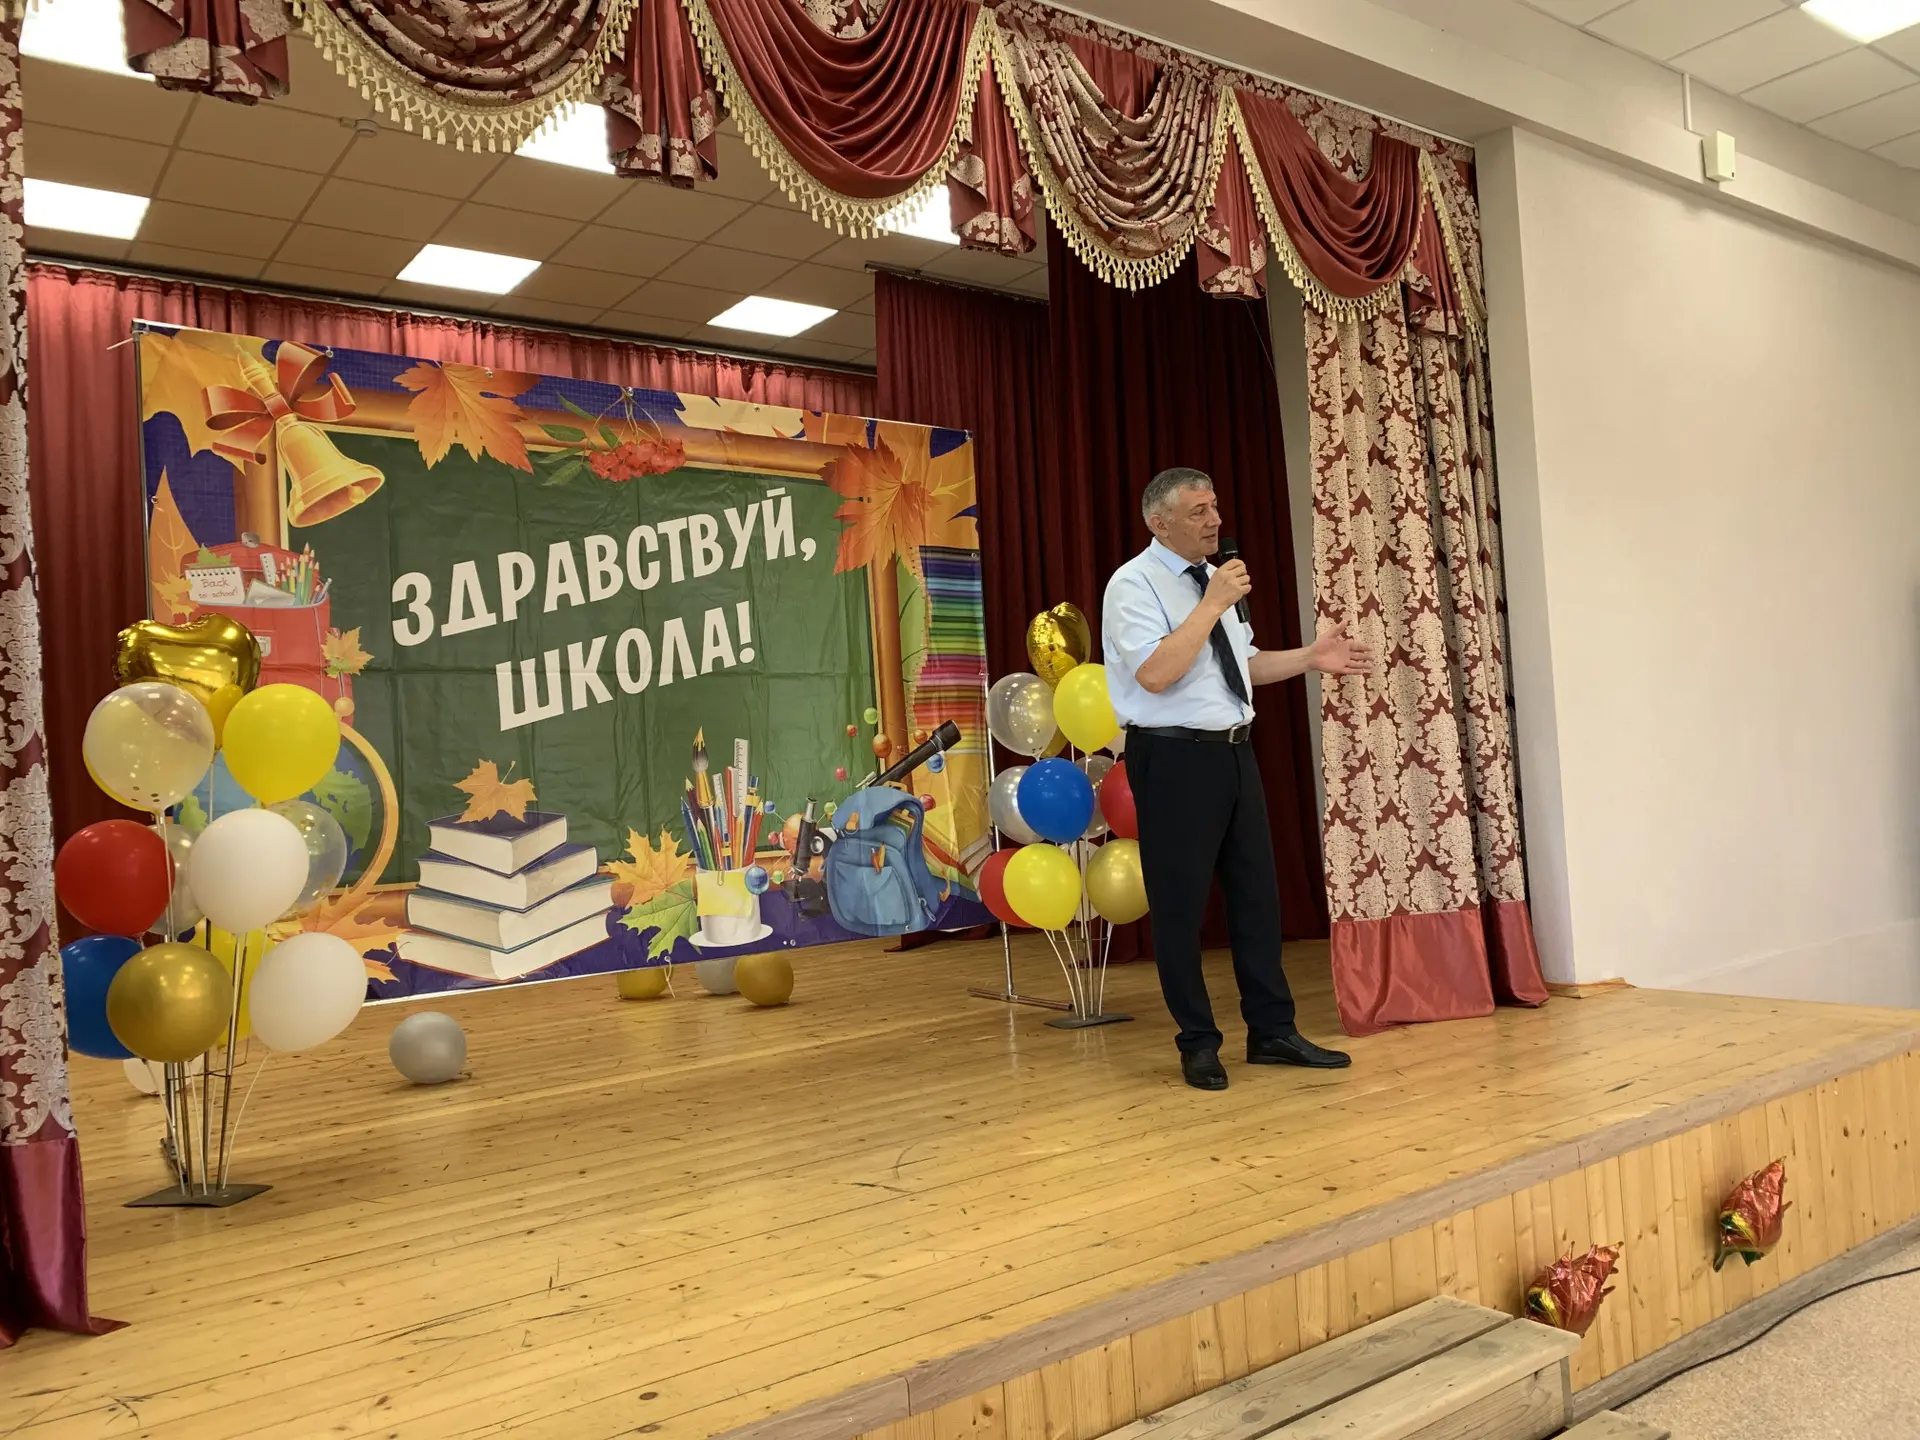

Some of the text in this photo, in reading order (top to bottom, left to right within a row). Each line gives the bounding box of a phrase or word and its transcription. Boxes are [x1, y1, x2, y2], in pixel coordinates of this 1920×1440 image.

[200, 578, 230, 588] Back
[391, 487, 817, 647] ЗДРАВСТВУЙ,
[495, 600, 756, 731] ШКОЛА!
